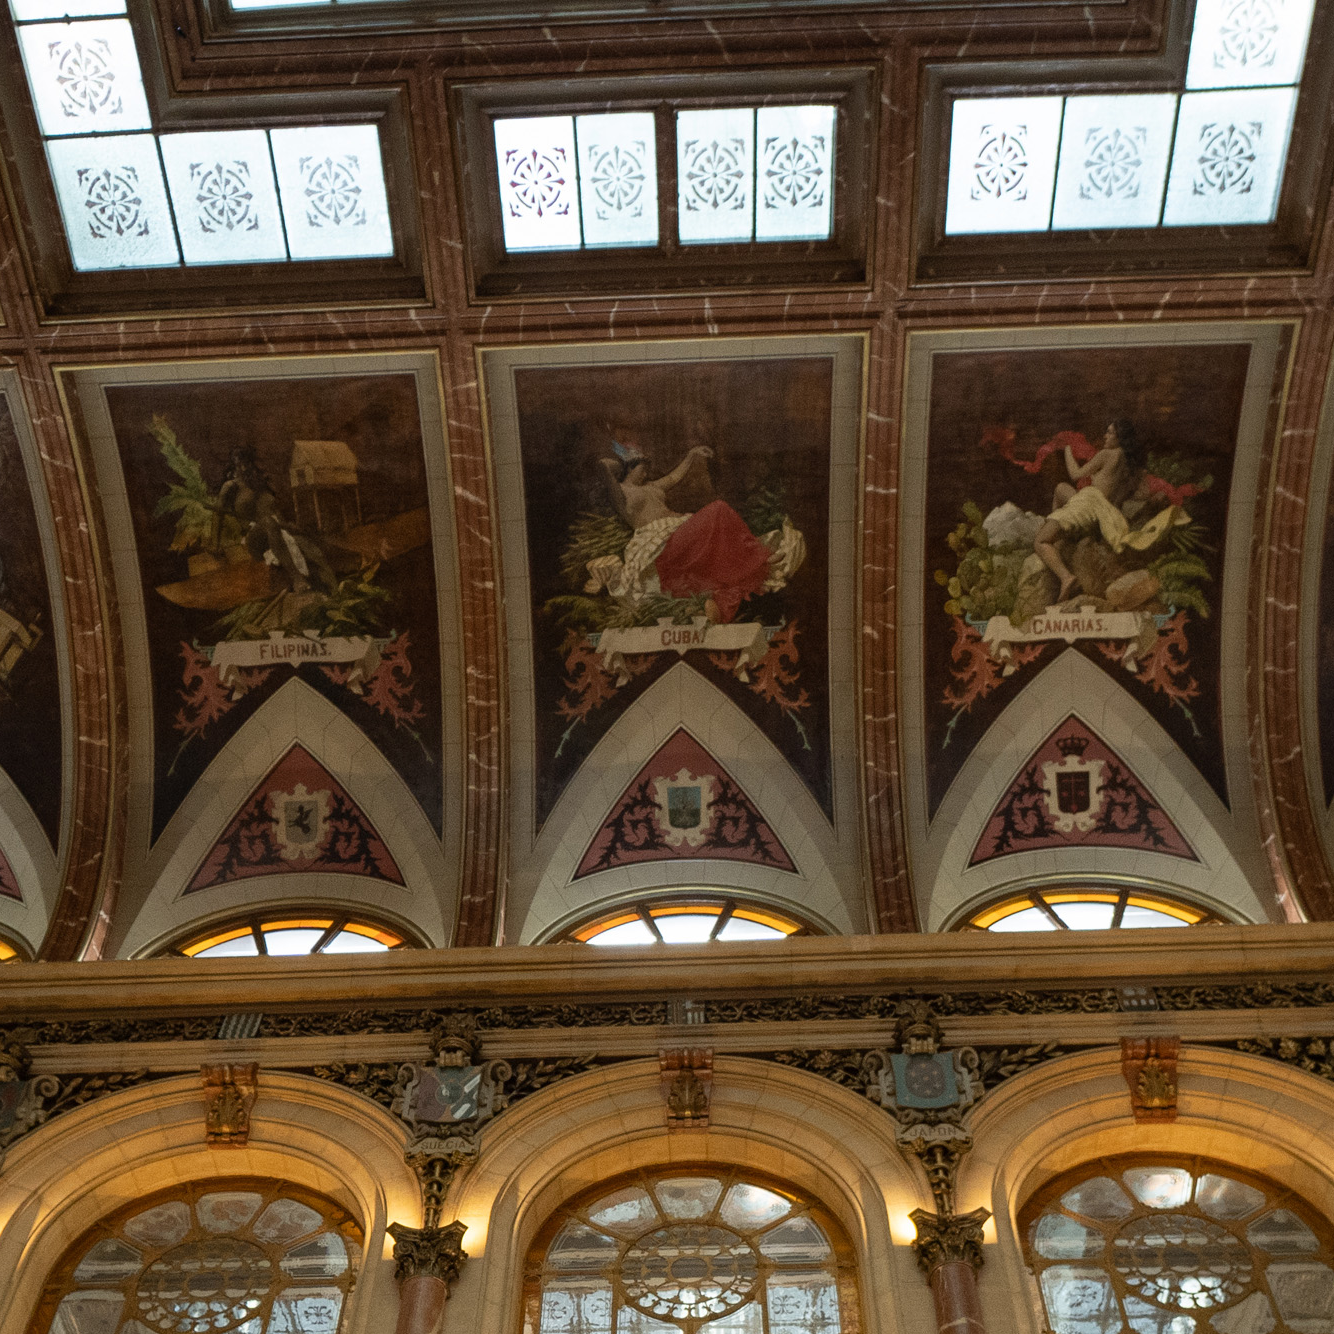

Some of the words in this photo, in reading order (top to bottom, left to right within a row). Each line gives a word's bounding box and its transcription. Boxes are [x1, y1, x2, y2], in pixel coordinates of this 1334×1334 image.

[1033, 618, 1108, 635] CANARIAS.
[260, 643, 332, 660] FILIPINAS.
[420, 1141, 467, 1151] SUECIA
